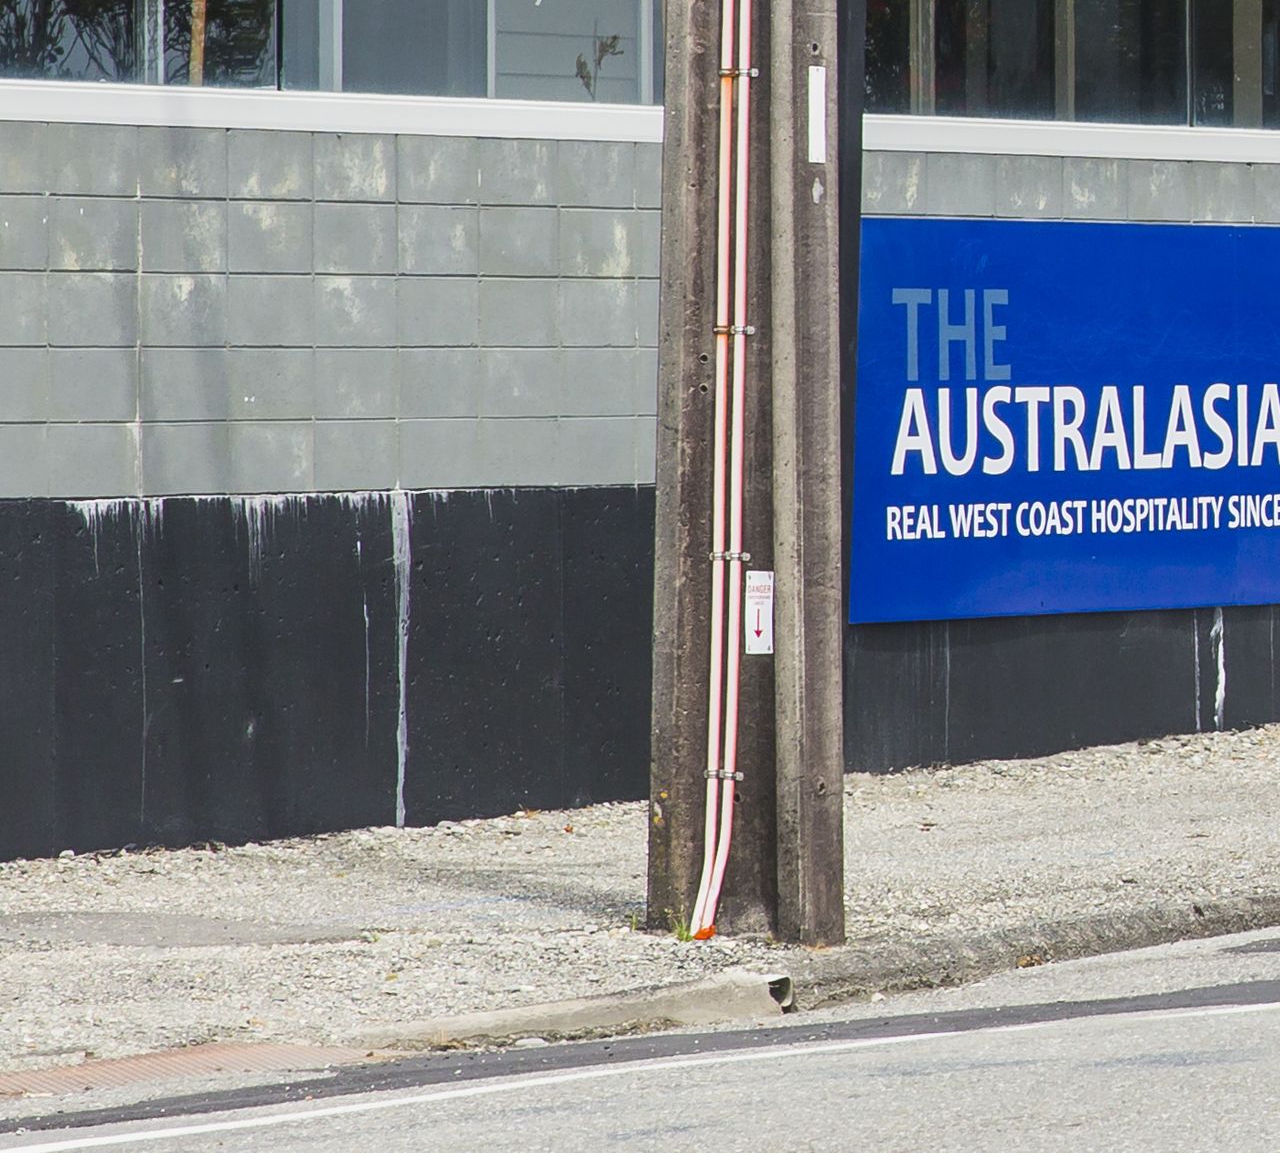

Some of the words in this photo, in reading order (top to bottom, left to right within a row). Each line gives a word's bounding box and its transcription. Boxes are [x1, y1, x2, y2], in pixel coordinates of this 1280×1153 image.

[892, 288, 1012, 381] THE
[886, 505, 948, 541] REAL
[950, 501, 1012, 538] WEST
[1015, 499, 1087, 536] COAST
[1091, 495, 1225, 535] HOSPITALITY
